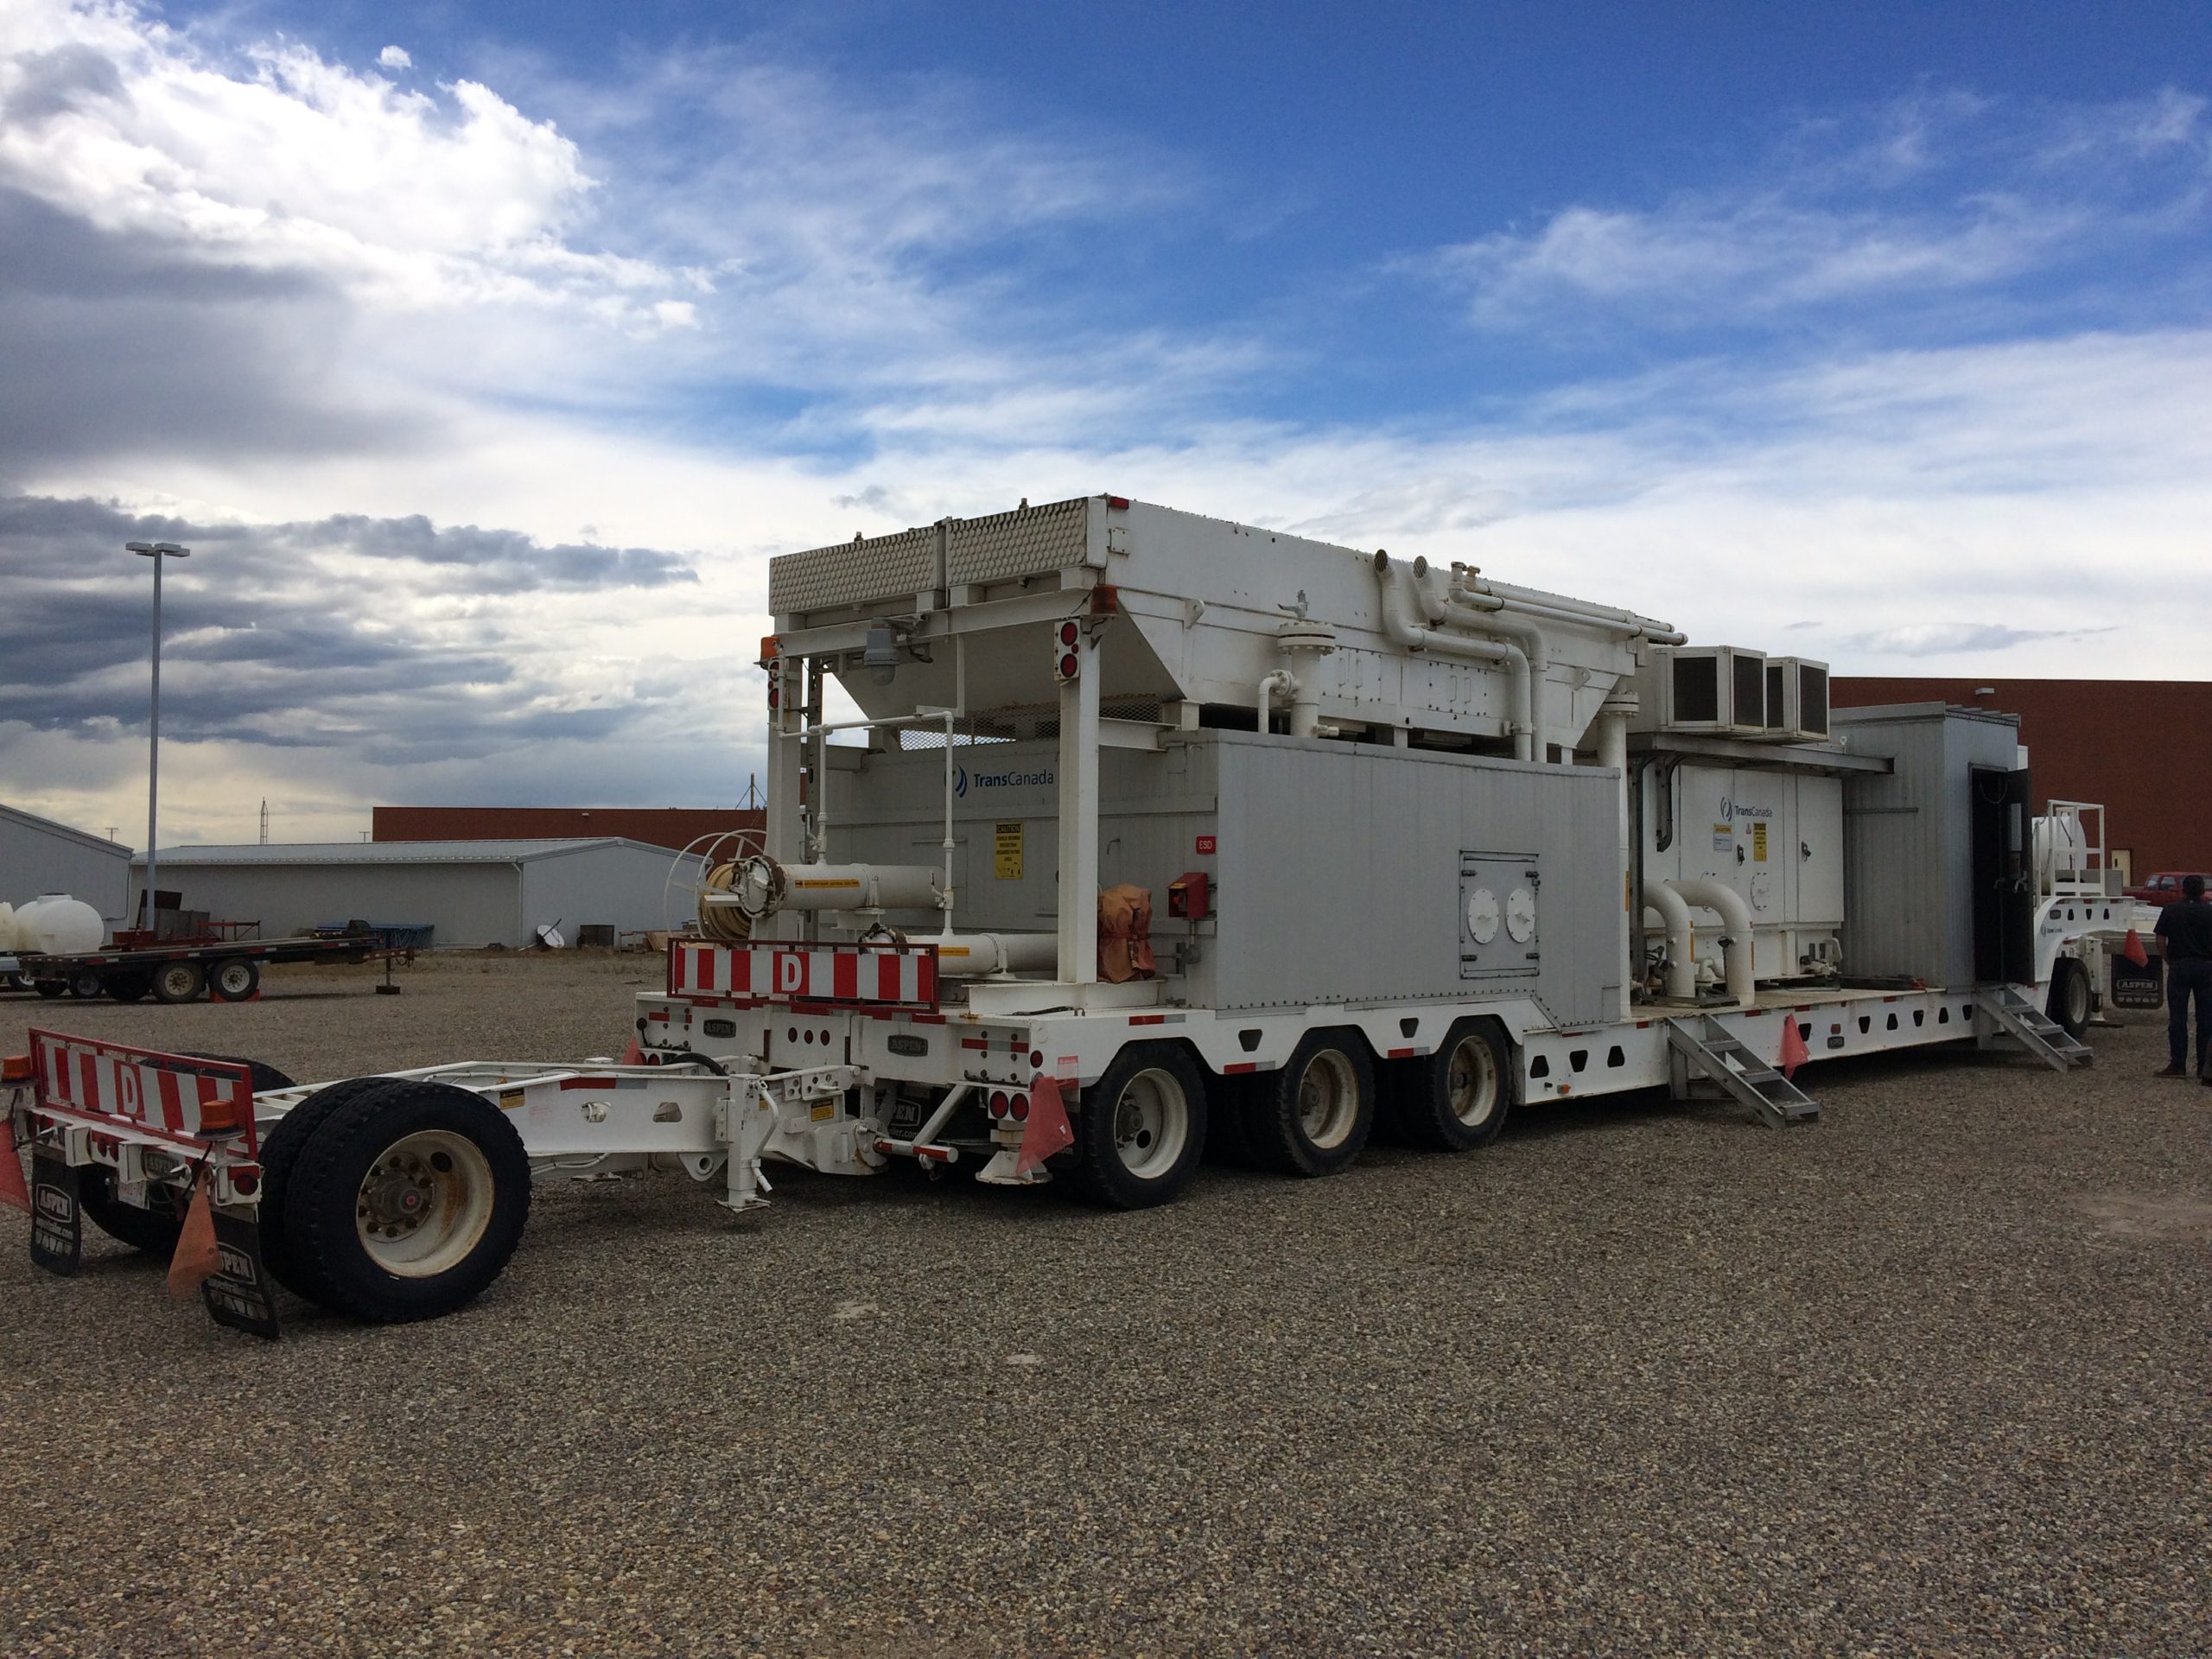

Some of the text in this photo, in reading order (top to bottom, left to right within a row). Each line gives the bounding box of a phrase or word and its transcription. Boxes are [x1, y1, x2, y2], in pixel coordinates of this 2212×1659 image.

[974, 769, 1053, 787] TransCanada
[1735, 804, 1773, 817] TransCanada
[1198, 840, 1212, 849] ESD
[781, 954, 802, 991] D
[706, 1022, 732, 1034] ASPEN
[892, 1039, 922, 1052] ASPEN
[120, 1064, 138, 1115] D
[40, 1189, 68, 1218] ASPEN
